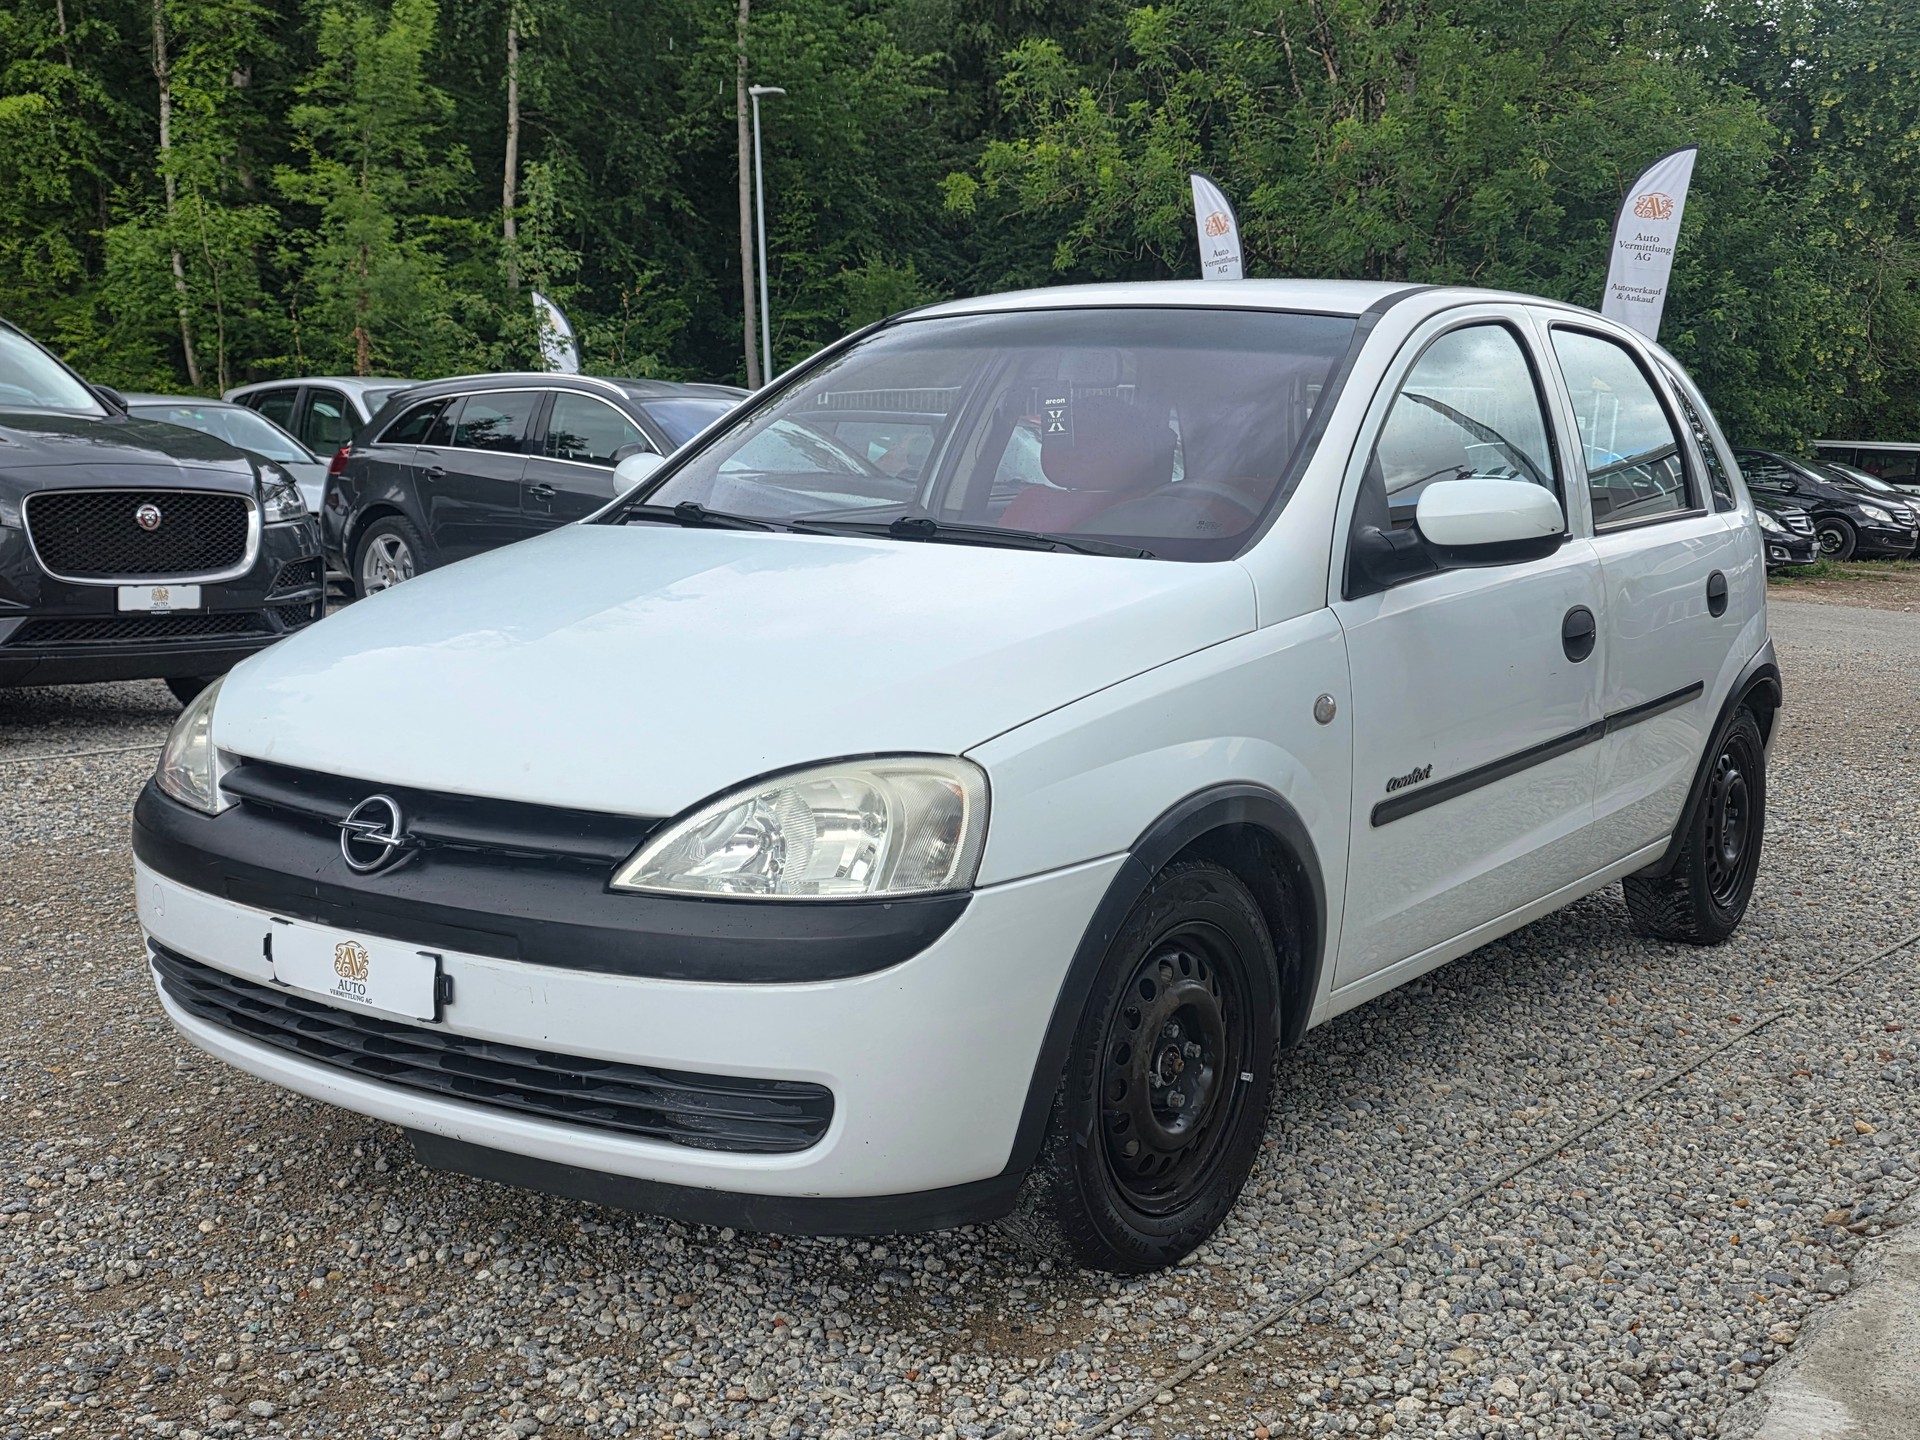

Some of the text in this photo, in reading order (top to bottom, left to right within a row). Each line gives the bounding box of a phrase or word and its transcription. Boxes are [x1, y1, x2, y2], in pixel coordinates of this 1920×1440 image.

[1634, 232, 1660, 243] Auto
[1213, 249, 1229, 258] Auto
[1618, 240, 1672, 255] Vermittlung
[1203, 255, 1239, 268] Vermittlung
[1634, 252, 1652, 262] AG
[1217, 265, 1228, 275] AG
[1610, 283, 1662, 296] Autoverkauf
[1624, 294, 1655, 304] Ankauf
[1386, 763, 1433, 793] Comfort
[337, 979, 366, 995] AUTO
[329, 988, 373, 1005] VERMITTLUNG AG
